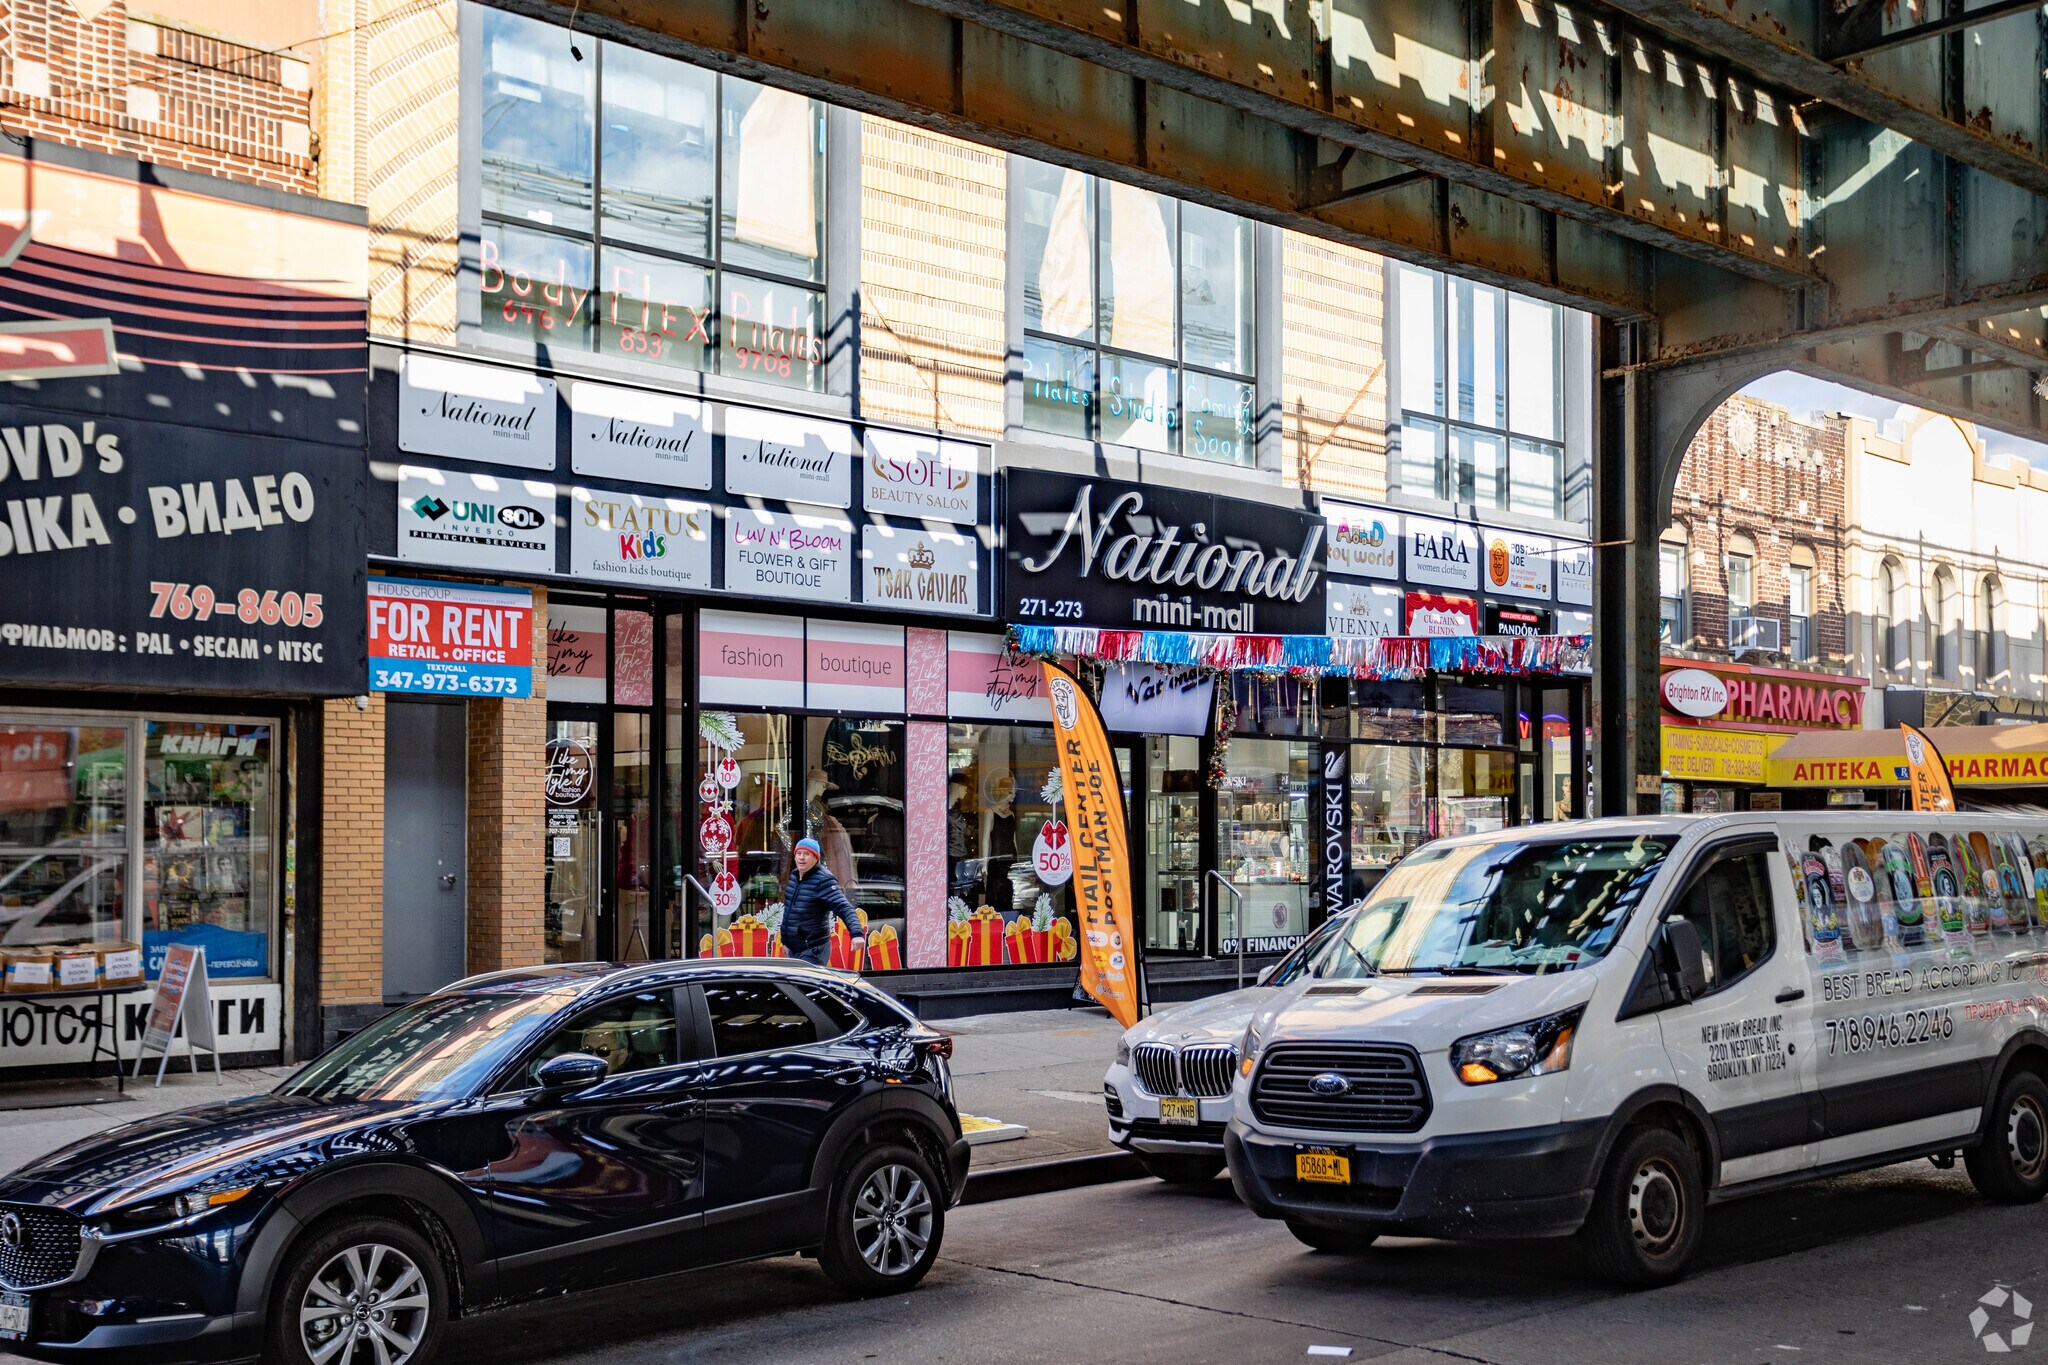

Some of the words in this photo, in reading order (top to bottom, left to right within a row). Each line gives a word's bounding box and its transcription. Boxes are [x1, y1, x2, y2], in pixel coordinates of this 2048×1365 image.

[502, 299, 555, 330] 646
[619, 326, 663, 358] 833
[736, 346, 791, 378] 9708
[421, 391, 536, 431] National
[493, 429, 530, 441] mini-mall
[591, 416, 694, 454] National
[655, 451, 689, 462] mini-mall
[742, 438, 835, 474] National
[799, 472, 830, 483] mini-mall
[148, 471, 315, 539] ВИДЕО
[871, 486, 923, 505] BEAUTY
[926, 493, 969, 511] SALON
[443, 523, 515, 537] INVESCO
[584, 500, 701, 539] STATUS
[412, 531, 479, 544] FINANCIAL
[485, 538, 544, 551] SERVICES
[619, 530, 667, 562] Kids
[1021, 484, 1325, 604] National
[1414, 532, 1470, 564] FARA
[739, 550, 793, 568] FLOWER
[797, 556, 806, 569] &
[809, 557, 838, 572] GIFT
[1327, 543, 1350, 568] toy
[1354, 548, 1394, 567] world
[1511, 556, 1525, 567] JOE
[592, 559, 626, 573] fashion
[629, 563, 649, 576] kids
[650, 565, 692, 581] boutique
[756, 569, 821, 588] BOUTIQUE
[1417, 562, 1441, 573] women
[1442, 564, 1467, 580] clothing
[378, 583, 410, 597] FIDUS
[412, 586, 450, 600] GROUP
[873, 566, 913, 600] TSAR
[917, 572, 968, 605] CAVIAR
[149, 581, 324, 629] 769-8605
[1019, 598, 1083, 619] 271-273
[1132, 593, 1254, 633] mini-mall
[370, 599, 430, 644] FOR
[442, 605, 523, 649] RENT
[1328, 616, 1390, 636] VIENNA
[0, 622, 127, 653] ФИЛЬМОВ:
[136, 632, 174, 656] PAL
[193, 637, 260, 660] SECAM
[278, 640, 324, 664] NTSC
[388, 643, 440, 660] RETAIL
[452, 648, 506, 663] OFFICE
[426, 663, 468, 673] TEXT/CALL
[562, 648, 593, 674] my
[721, 645, 783, 668] fashion
[820, 652, 892, 679] boutique
[375, 670, 518, 694] 347-973-6373
[1668, 682, 1699, 702] Brighton
[1701, 686, 1711, 702] RX
[1712, 687, 1725, 703] Inc.
[1726, 680, 1866, 725] PHARMACY
[1669, 755, 1685, 771] FREE
[1687, 756, 1716, 773] DELIVERY
[1793, 761, 1882, 781] АПТЕКА
[565, 768, 589, 787] my
[1039, 852, 1070, 871] 50%
[1326, 783, 1343, 921] WAROVSKI
[1822, 973, 1859, 1002] BEST
[1865, 968, 1914, 999] BREAD
[1919, 960, 2001, 992] ACCORDING
[124, 998, 265, 1041] КГИ
[1701, 1025, 1719, 1044] NEW
[1720, 1022, 1740, 1041] YORK
[1770, 1014, 1784, 1032] INC.
[1825, 1008, 1954, 1056] 718.946.2246
[1709, 1043, 1729, 1063] 2201
[1729, 1036, 1765, 1059] NEPTUNE
[1766, 1034, 1781, 1053] AVE
[1707, 1058, 1750, 1082] BROOKLYN,
[1751, 1055, 1762, 1074] NY
[1765, 1051, 1787, 1072] 11224
